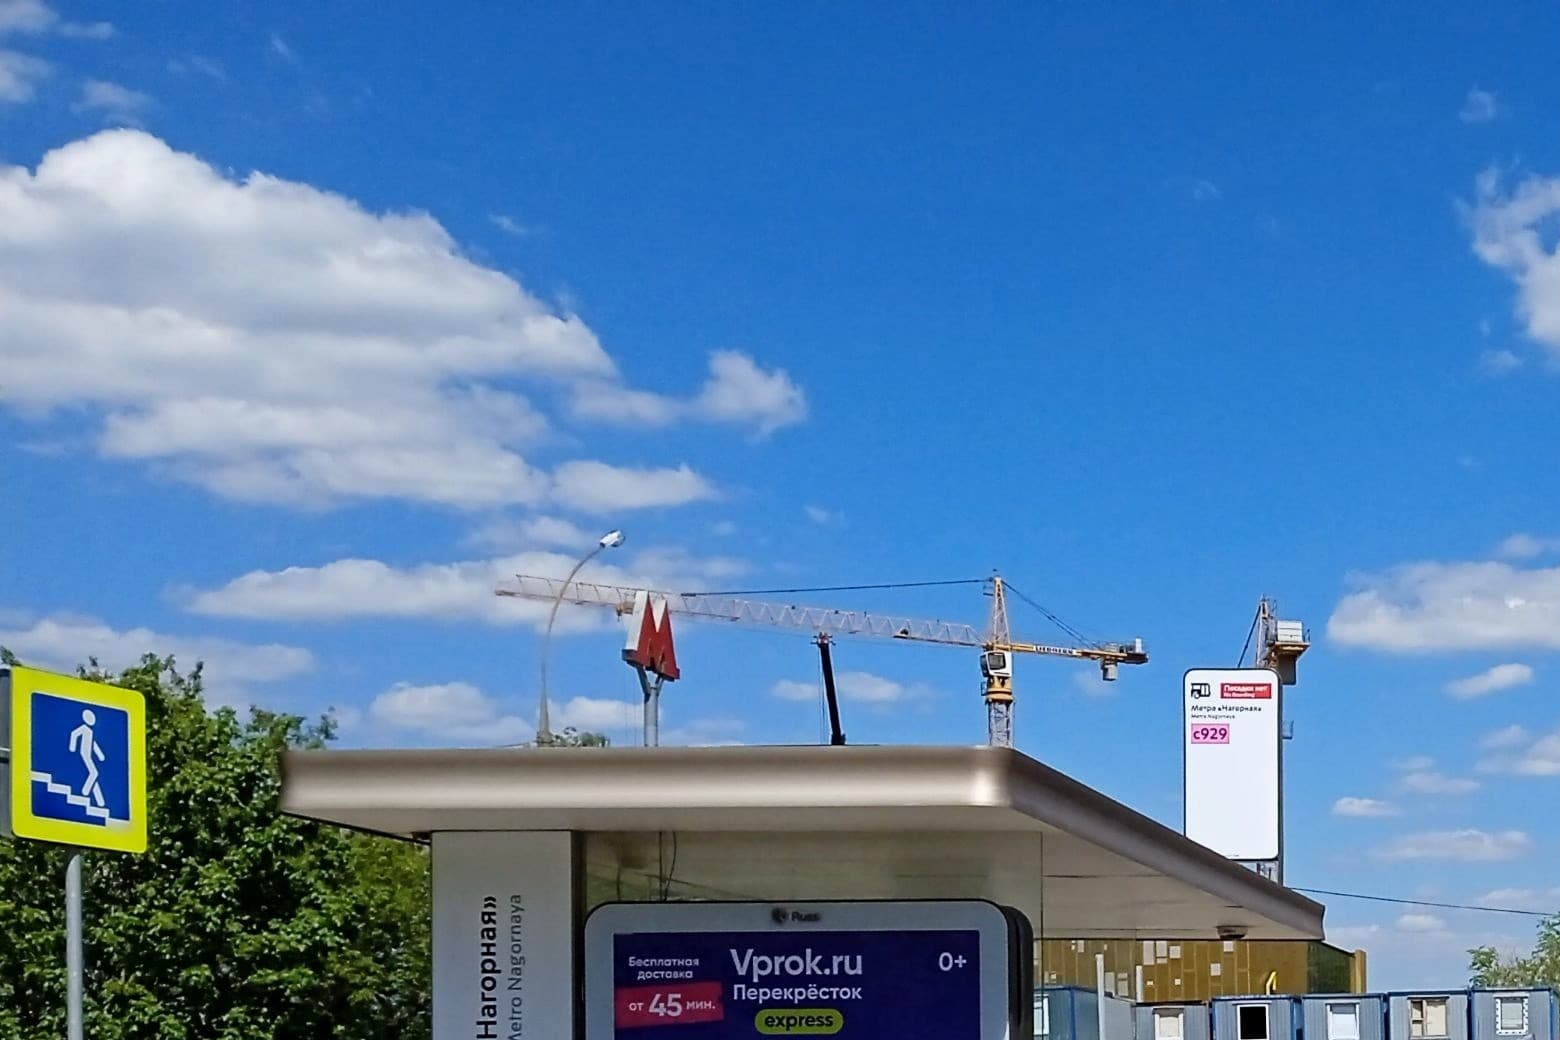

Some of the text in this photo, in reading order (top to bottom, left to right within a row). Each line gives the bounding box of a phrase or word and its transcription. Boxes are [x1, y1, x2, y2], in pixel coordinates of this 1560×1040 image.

[508, 894, 526, 992] Nagornaya
[628, 956, 700, 967] Бесплатная
[730, 948, 863, 983] Vprok.ru
[938, 952, 967, 972] 0+
[637, 968, 694, 980] доставка
[732, 983, 863, 1004] Перекрёсток
[628, 993, 716, 1018] от 45 мин.
[764, 1013, 834, 1031] express
